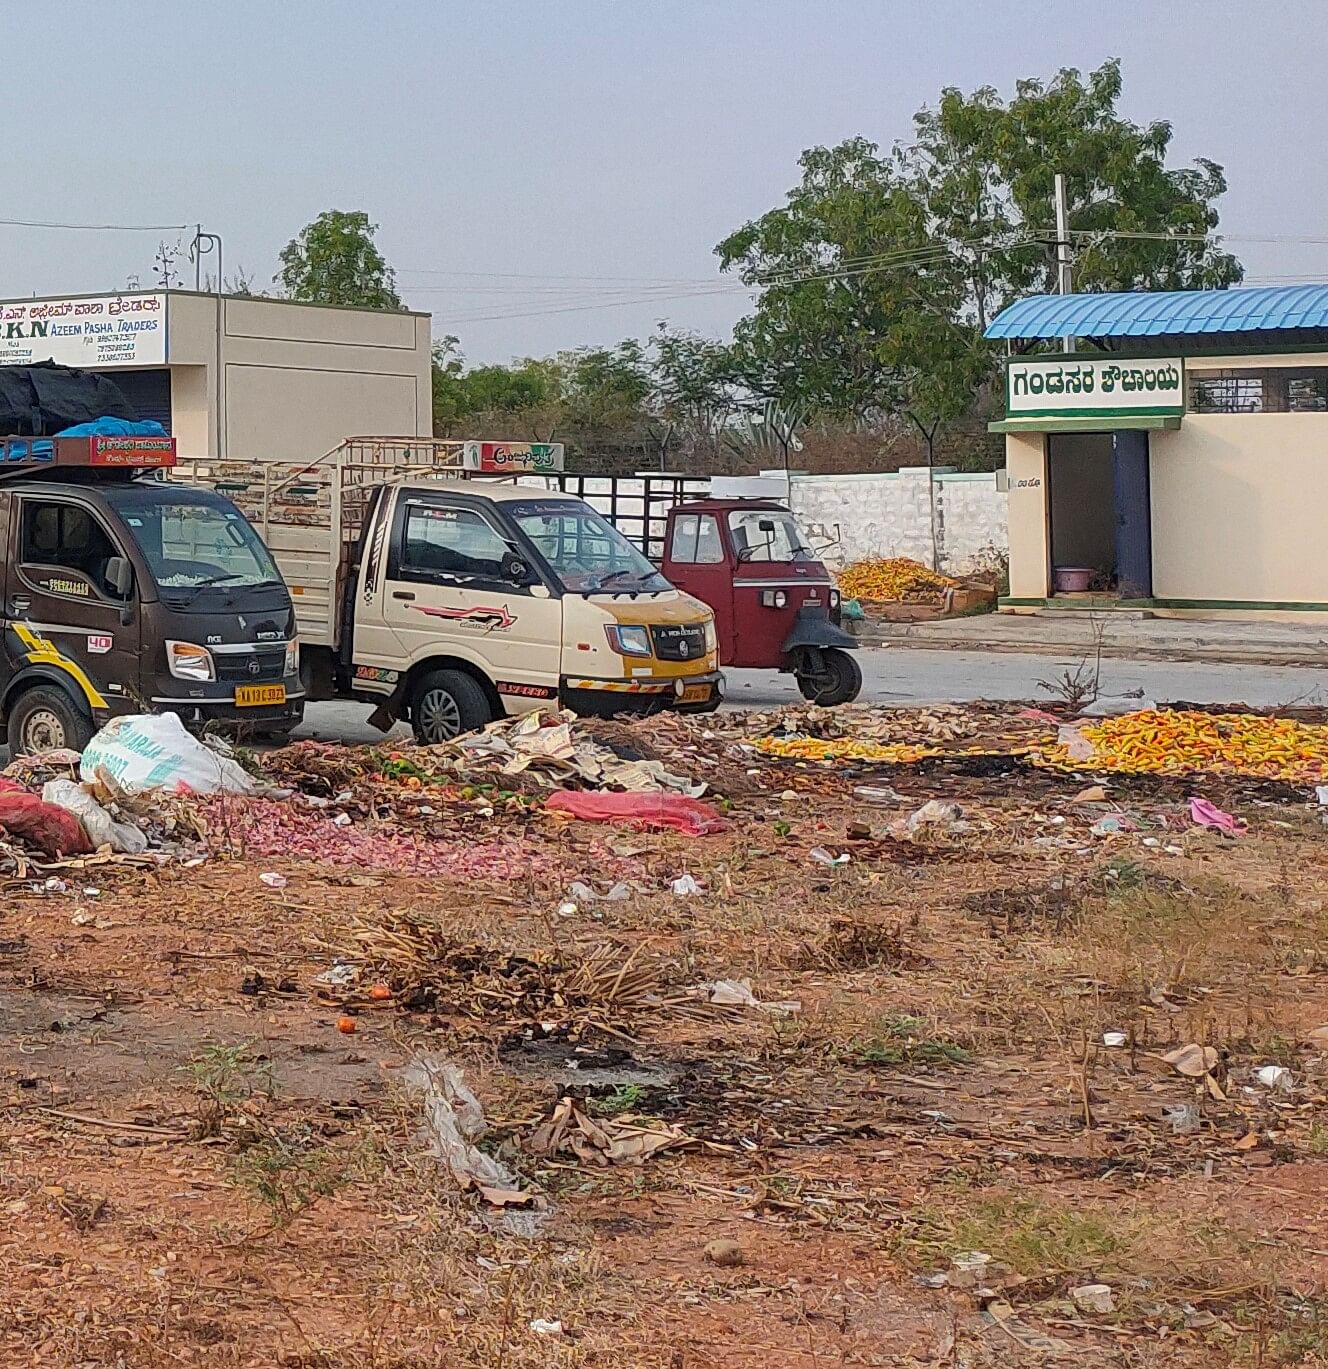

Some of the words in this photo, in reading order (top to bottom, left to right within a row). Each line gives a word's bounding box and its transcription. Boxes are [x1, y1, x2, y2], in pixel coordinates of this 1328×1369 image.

[51, 324, 82, 336] AZEEM
[85, 321, 113, 334] PASHA
[117, 319, 158, 331] TRADERS
[1013, 365, 1094, 395] ಗಂಡಸರ
[1101, 363, 1179, 392] ಶೌಚಾಲಯ
